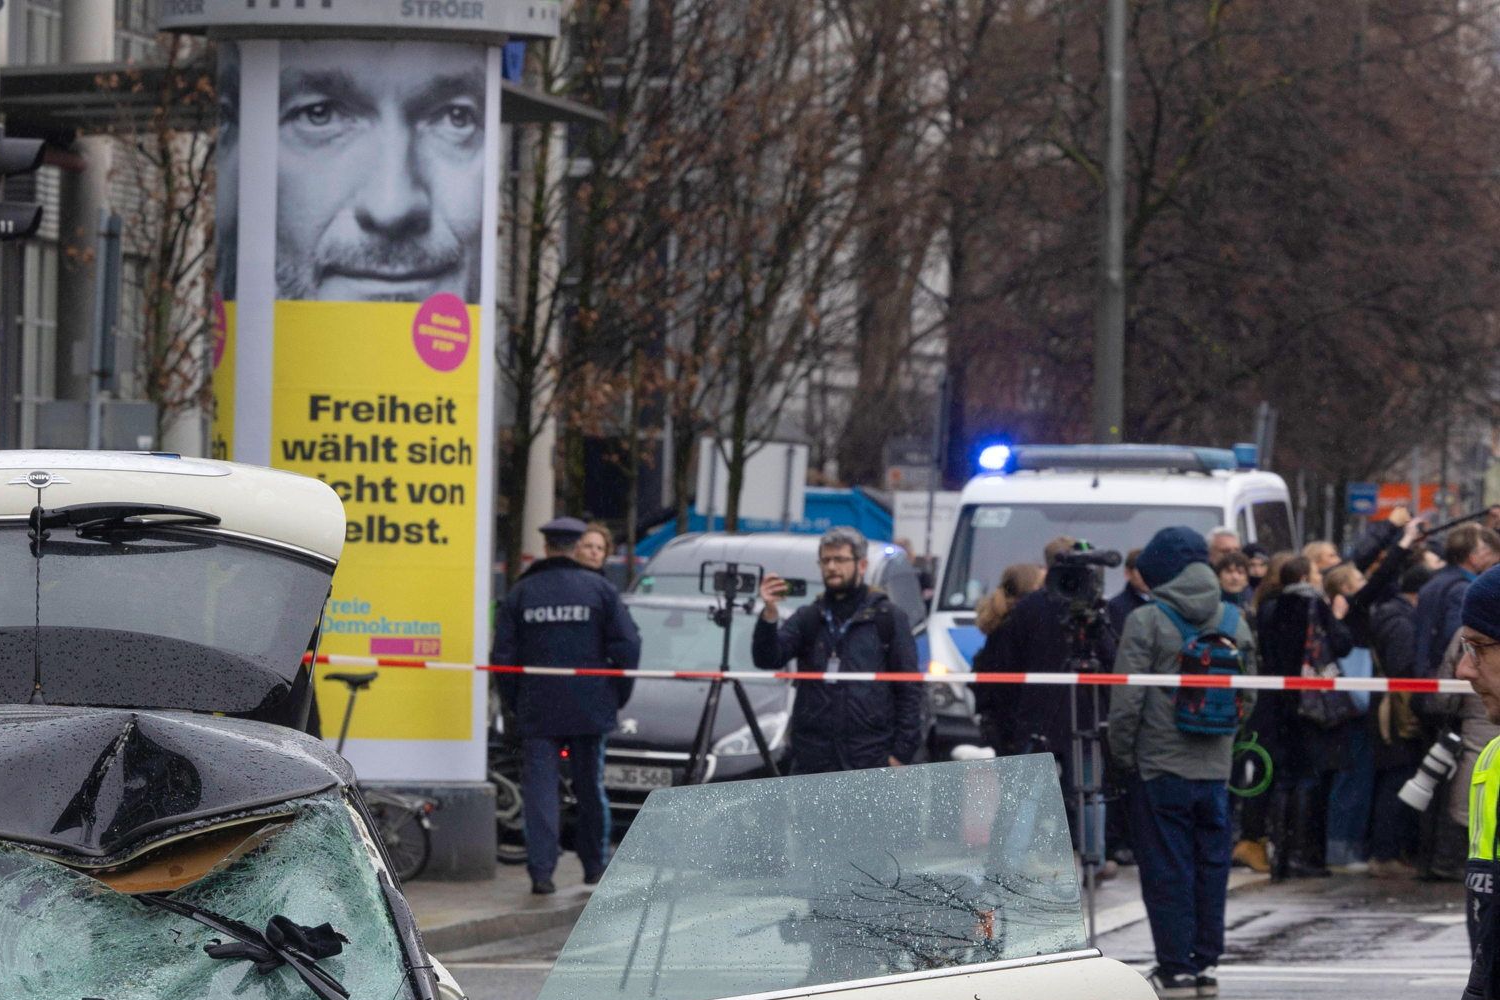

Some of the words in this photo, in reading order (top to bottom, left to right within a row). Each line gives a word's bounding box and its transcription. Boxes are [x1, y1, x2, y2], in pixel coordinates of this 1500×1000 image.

[309, 395, 457, 425] Freiheit
[281, 434, 398, 464] wählt
[407, 436, 472, 466] sich
[325, 473, 398, 504] cht
[407, 482, 465, 506] von
[345, 515, 449, 545] elbst.
[329, 597, 371, 615] reie
[523, 605, 591, 623] POLIZEI
[320, 616, 442, 636] Demokraten
[412, 640, 441, 654] FDP
